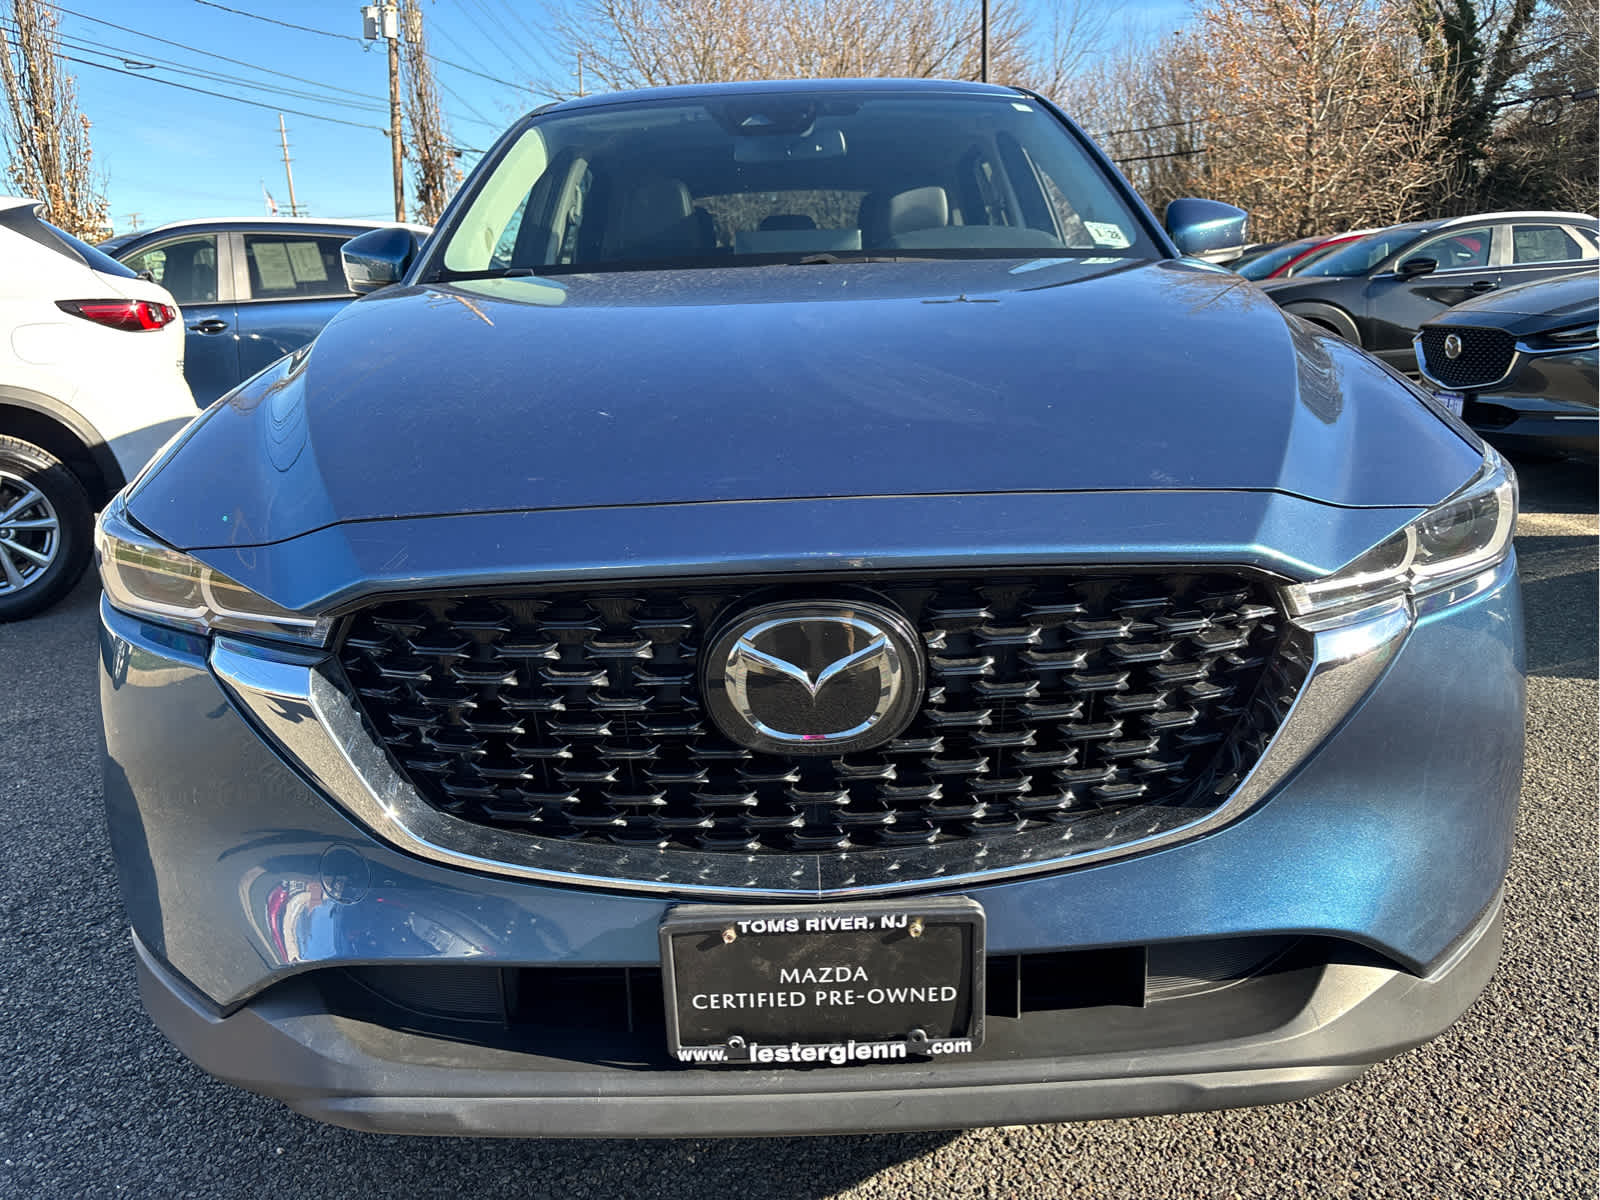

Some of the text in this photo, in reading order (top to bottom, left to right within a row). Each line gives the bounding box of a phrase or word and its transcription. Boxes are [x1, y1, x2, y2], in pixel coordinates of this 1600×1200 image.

[737, 914, 908, 934] TOMS RIVER, NJ
[779, 966, 869, 984] MAZDA
[692, 986, 958, 1010] CERTIFIED PRE-OWNED
[677, 1039, 972, 1065] www. lesterglenn .com
